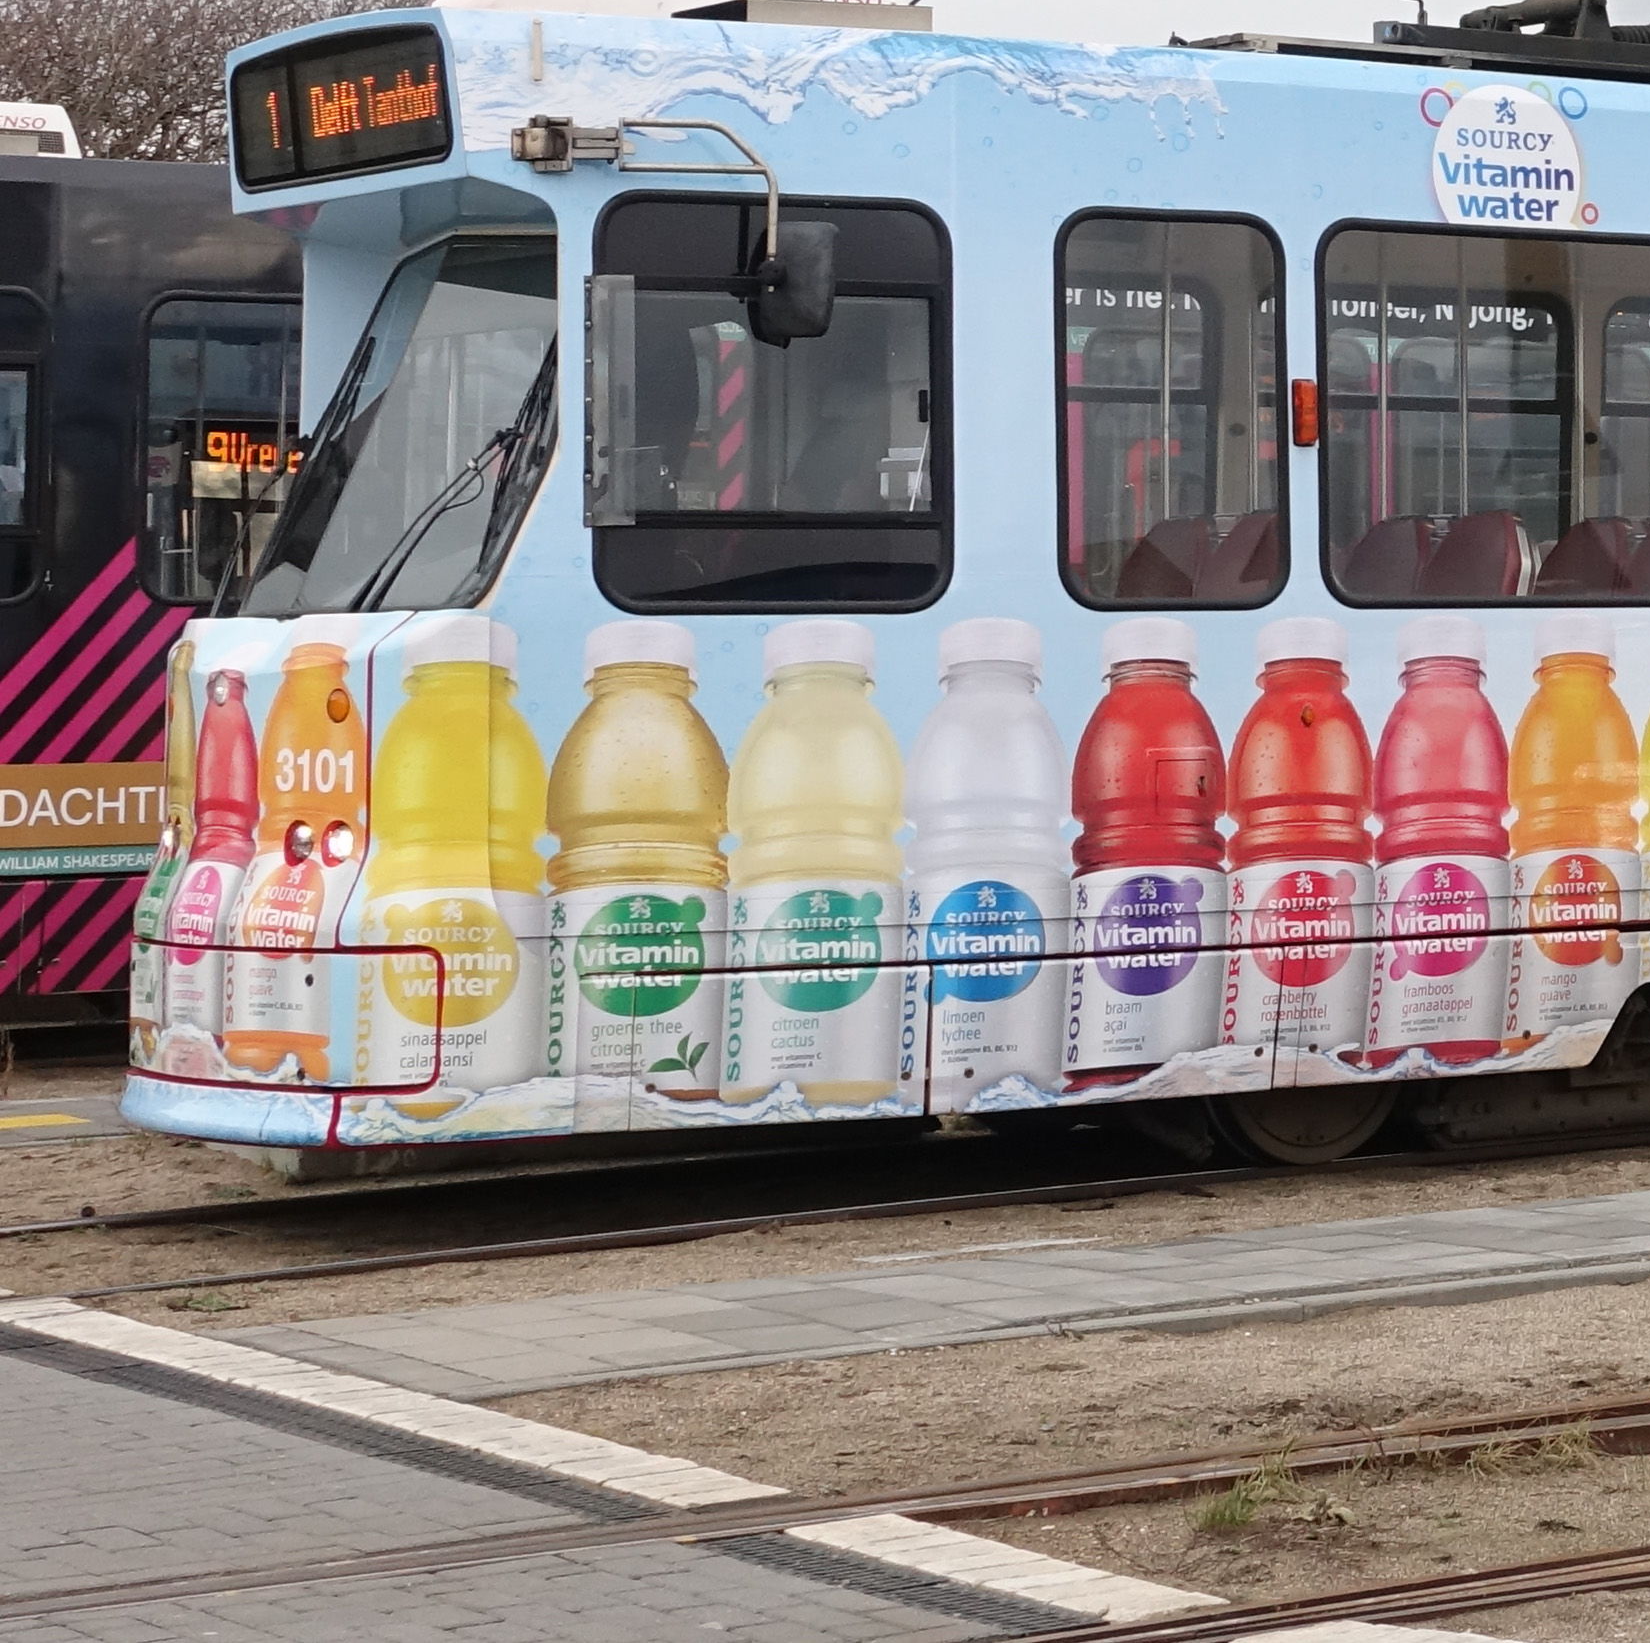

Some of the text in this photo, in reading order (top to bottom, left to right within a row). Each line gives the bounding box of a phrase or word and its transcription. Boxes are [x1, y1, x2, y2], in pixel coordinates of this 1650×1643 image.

[310, 64, 437, 138] Delft Tanthof
[267, 91, 280, 148] 1
[1457, 128, 1553, 152] SOURCY
[1457, 192, 1560, 222] water
[275, 748, 354, 793] 3101
[0, 855, 58, 871] WILLIAM
[261, 885, 314, 903] SOURCY
[1543, 880, 1608, 895] SOURCY
[1268, 896, 1338, 913] SOURCY
[944, 910, 1026, 927] SOURCY
[250, 928, 305, 948] water
[403, 926, 496, 943] SOURCY
[402, 973, 499, 997] water
[1403, 982, 1455, 998] framboos
[1541, 972, 1577, 990] mango
[1261, 991, 1317, 1007] cranberry
[1539, 988, 1571, 1005] guave
[1104, 1000, 1142, 1015] braam
[1260, 1004, 1328, 1023] rozenbottel
[1401, 996, 1473, 1017] granaatappel
[771, 1015, 820, 1032] citroen
[942, 1009, 986, 1024] limoen
[591, 1018, 683, 1041] groene thee
[941, 1025, 981, 1045] lychee
[771, 1034, 815, 1049] cactus
